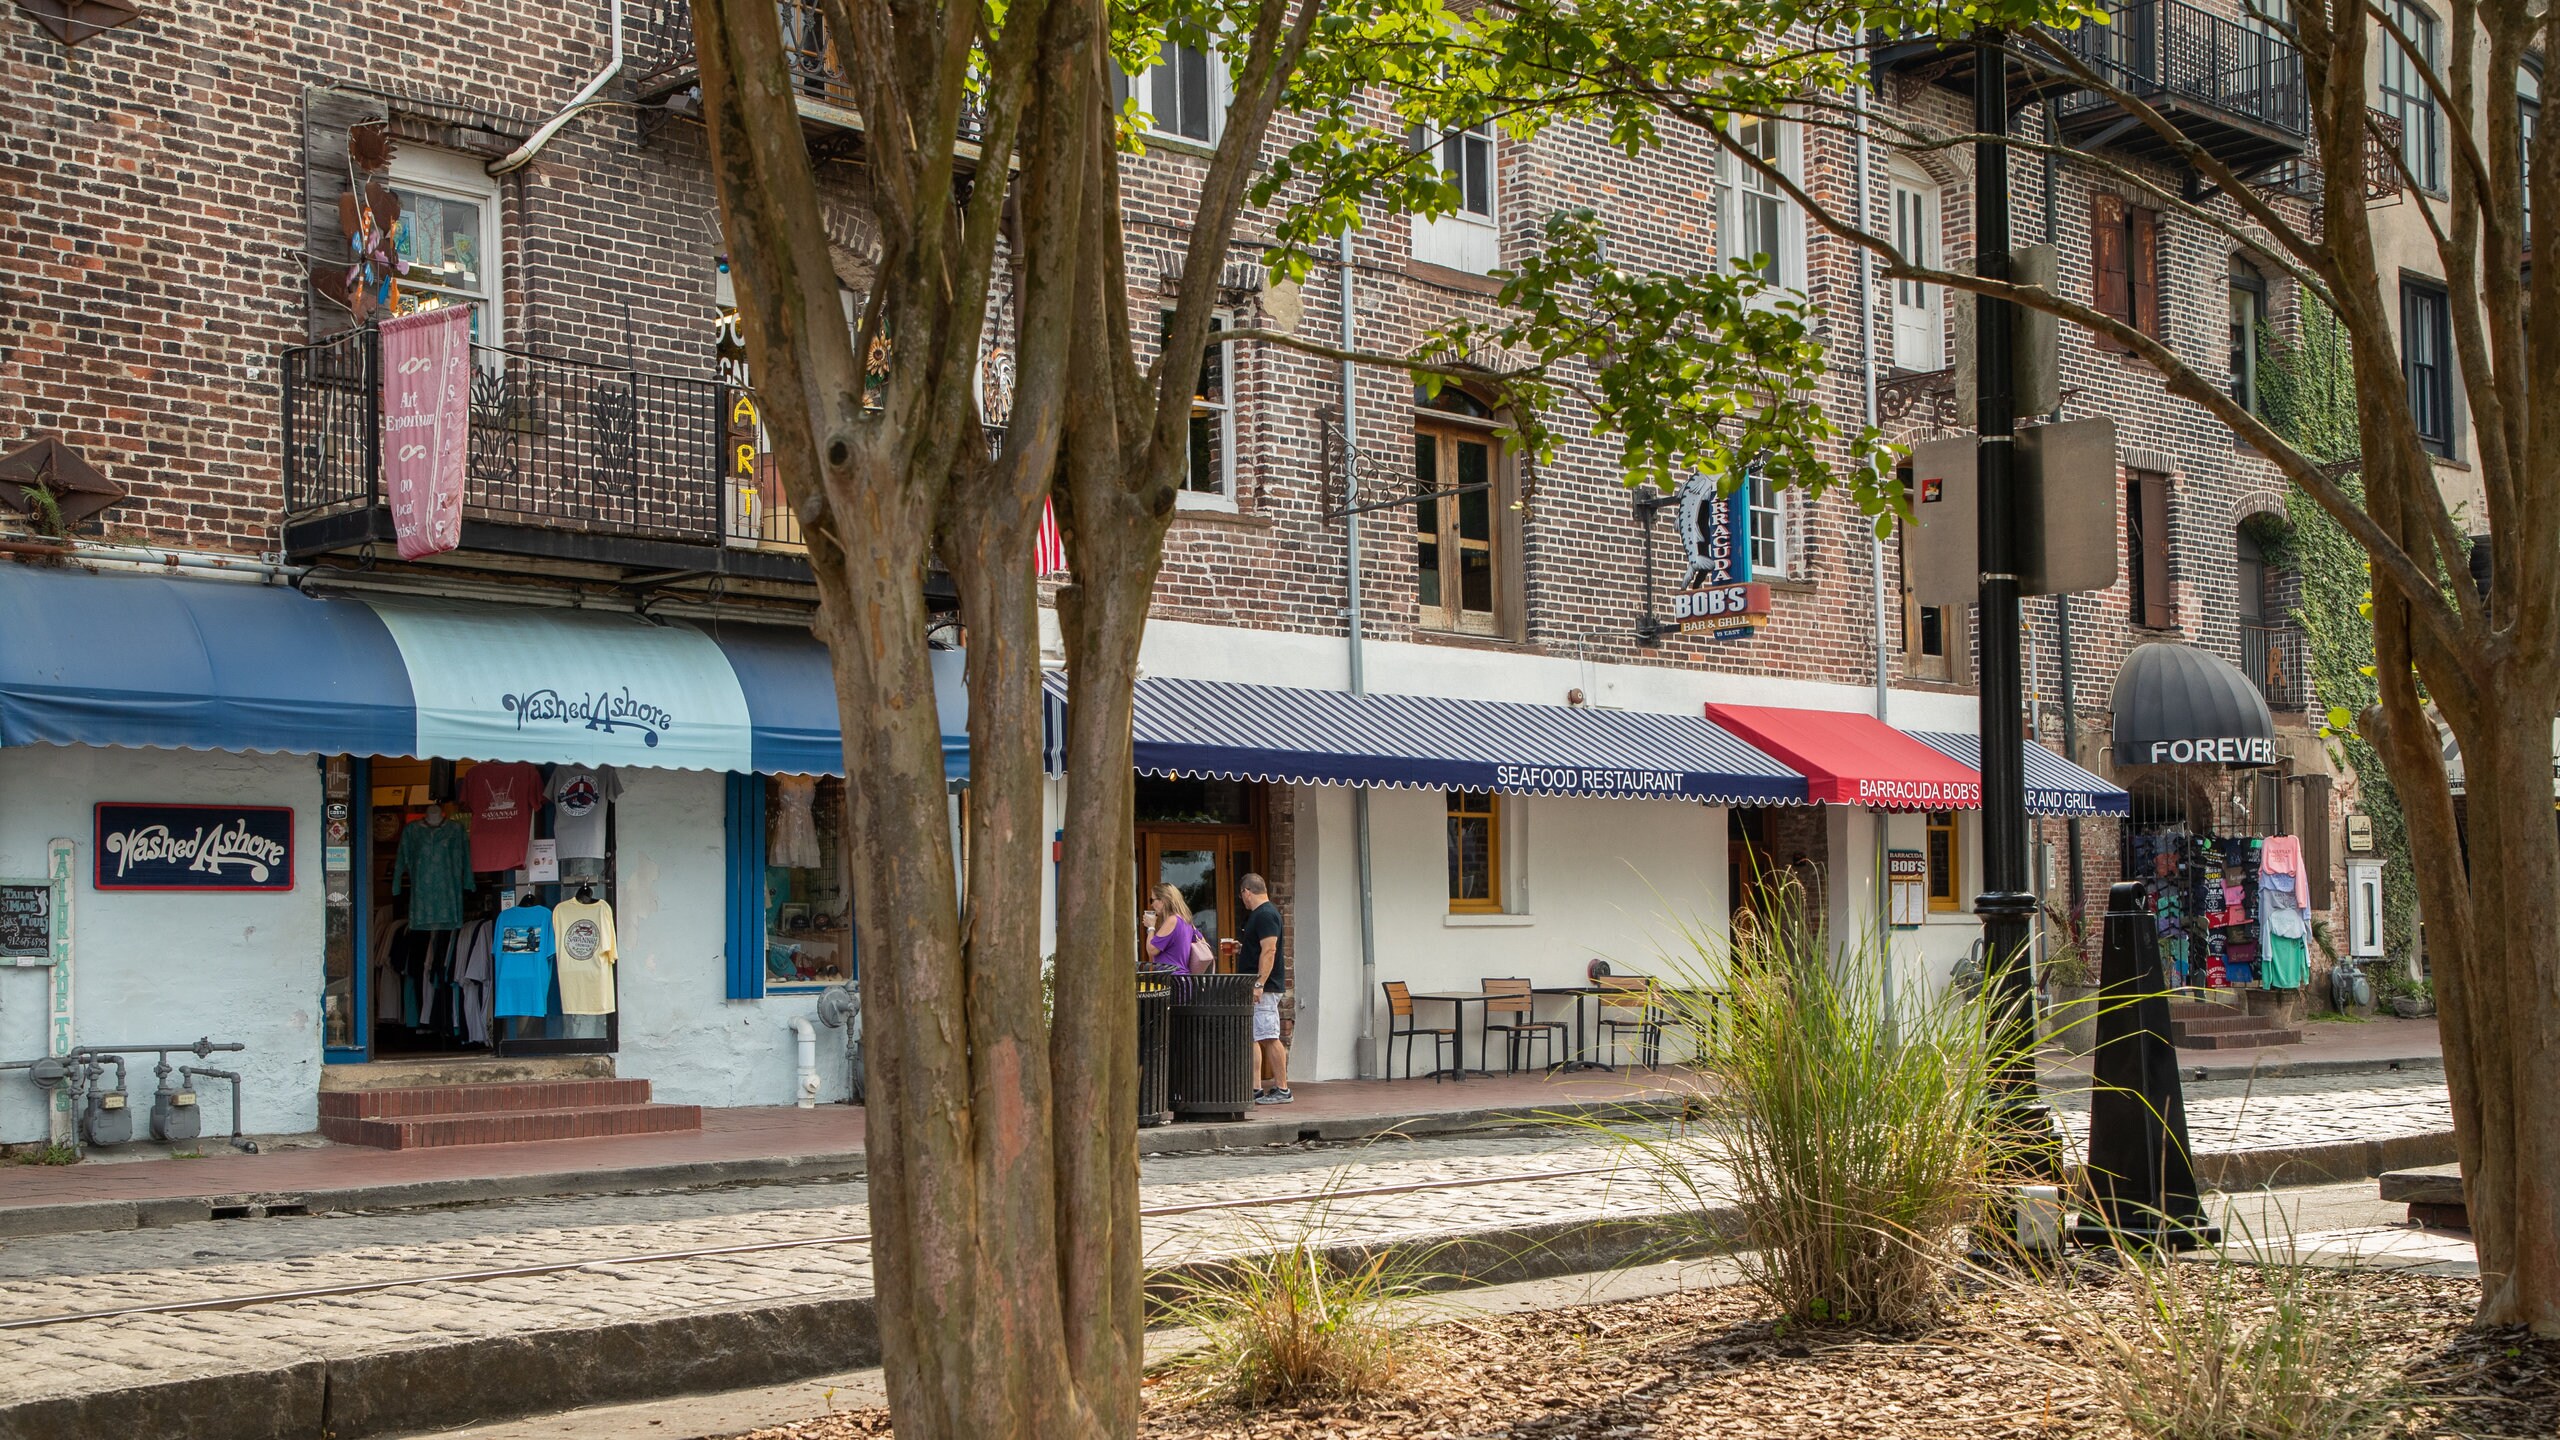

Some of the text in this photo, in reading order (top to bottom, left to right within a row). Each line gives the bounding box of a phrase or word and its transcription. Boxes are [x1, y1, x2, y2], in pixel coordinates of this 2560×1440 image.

[400, 391, 417, 409] Art
[734, 396, 757, 515] ART
[1675, 587, 1747, 619] BOB'S
[1683, 615, 1749, 632] BAR & GRILL
[502, 686, 671, 748] Washed Ashore
[1497, 765, 1684, 791] SEAFOOD RESTAURANT
[1860, 779, 1980, 800] BARRACUDA BOB'S
[2038, 792, 2061, 807] AND
[2064, 793, 2096, 809] GRILL
[481, 809, 518, 818] SAVANNAH
[107, 818, 285, 883] Washed Ashore
[1891, 860, 1926, 873] BOB'S
[3, 887, 35, 900] TAILOR
[2, 899, 38, 913] MADE
